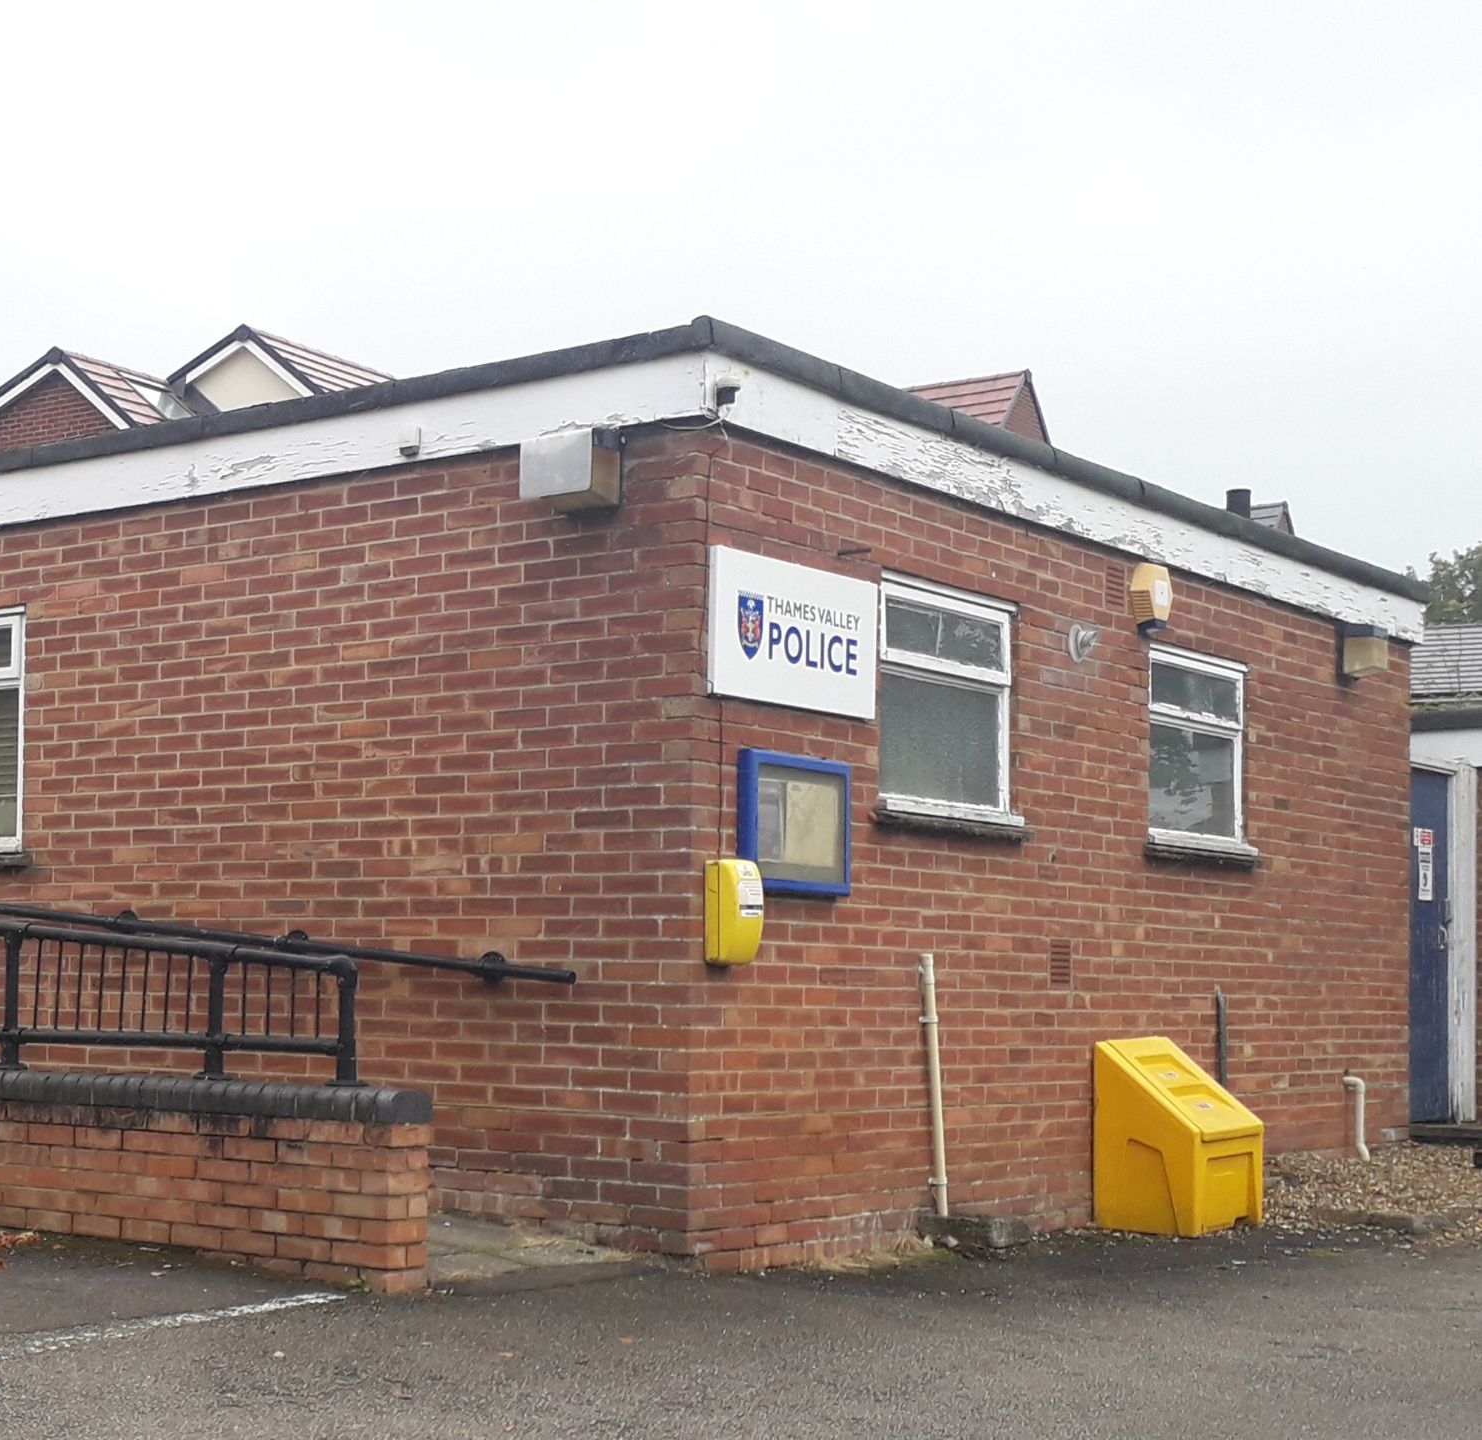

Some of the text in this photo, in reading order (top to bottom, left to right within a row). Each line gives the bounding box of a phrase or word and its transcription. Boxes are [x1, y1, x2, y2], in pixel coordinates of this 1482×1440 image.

[767, 596, 861, 631] THAMES VALLEY
[769, 622, 858, 676] POLICE
